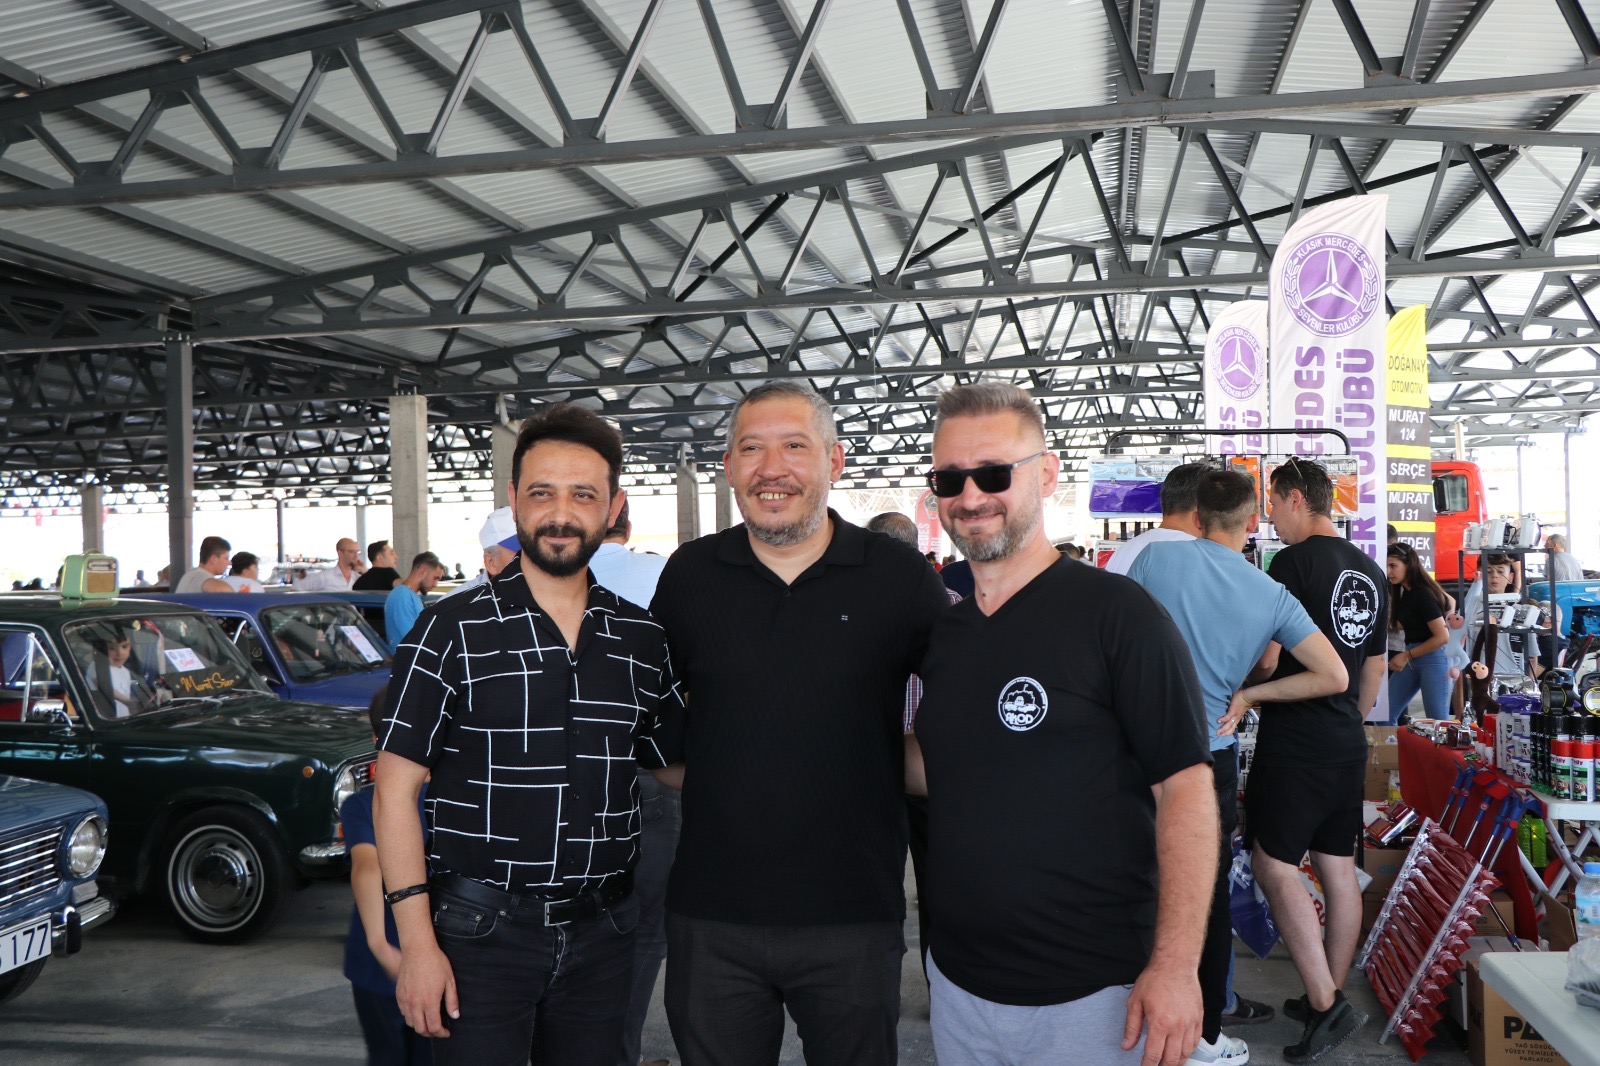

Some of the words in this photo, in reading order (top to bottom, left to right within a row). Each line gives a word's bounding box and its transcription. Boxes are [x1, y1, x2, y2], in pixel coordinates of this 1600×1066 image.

[1325, 237, 1366, 262] MERCEDES
[1298, 308, 1335, 333] SEVENLER
[1388, 353, 1426, 374] DOĞANAY
[1388, 408, 1426, 424] MURAT
[1400, 427, 1416, 441] 124
[1390, 462, 1426, 479] SERÇE
[1388, 491, 1431, 505] MURAT
[1399, 508, 1419, 521] 131
[12, 922, 49, 966] 177
